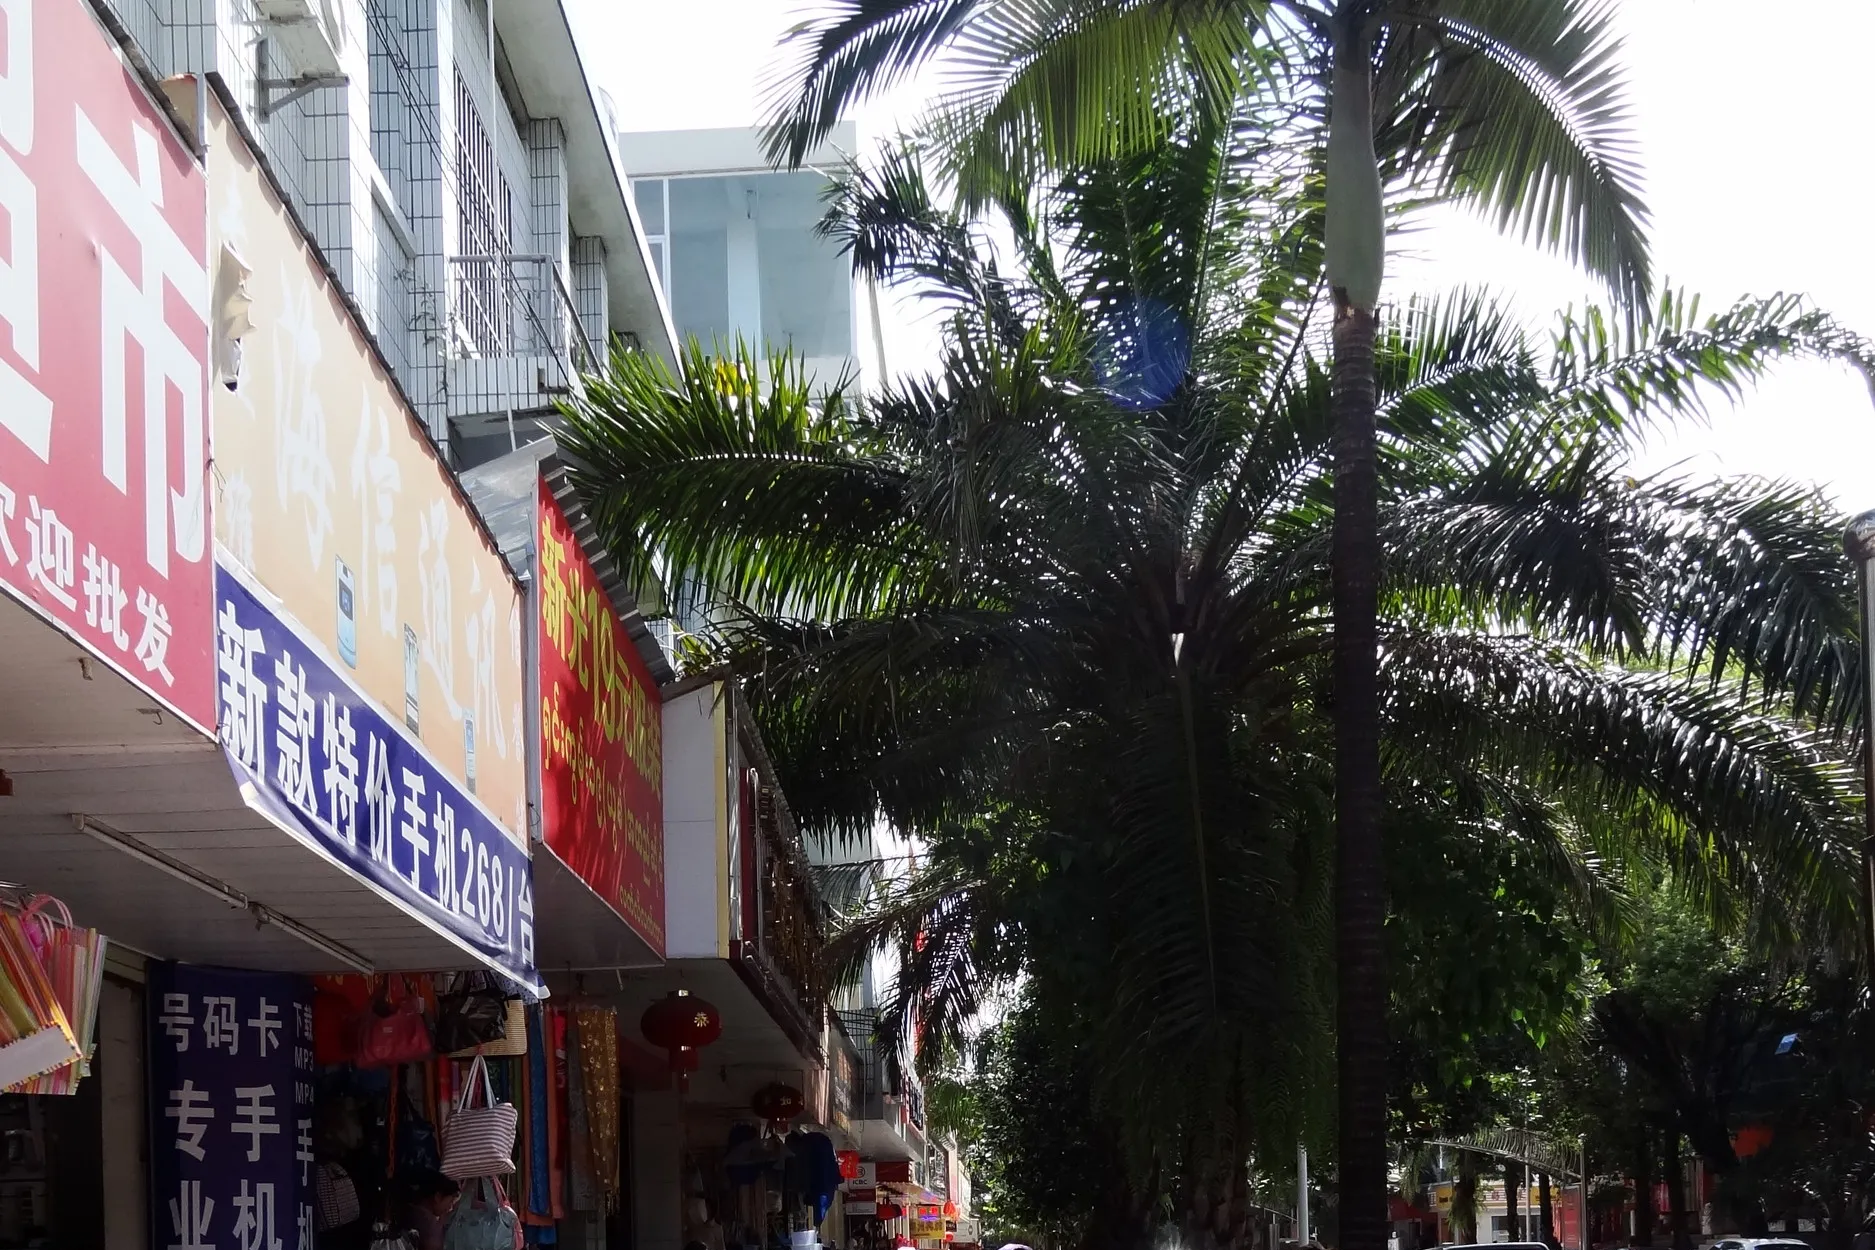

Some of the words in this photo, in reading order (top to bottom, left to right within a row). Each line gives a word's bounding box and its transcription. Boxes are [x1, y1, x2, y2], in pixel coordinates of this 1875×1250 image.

[218, 600, 534, 970] 新款特价手机268/台
[159, 993, 282, 1057] 号码卡
[294, 1046, 314, 1072] MP3
